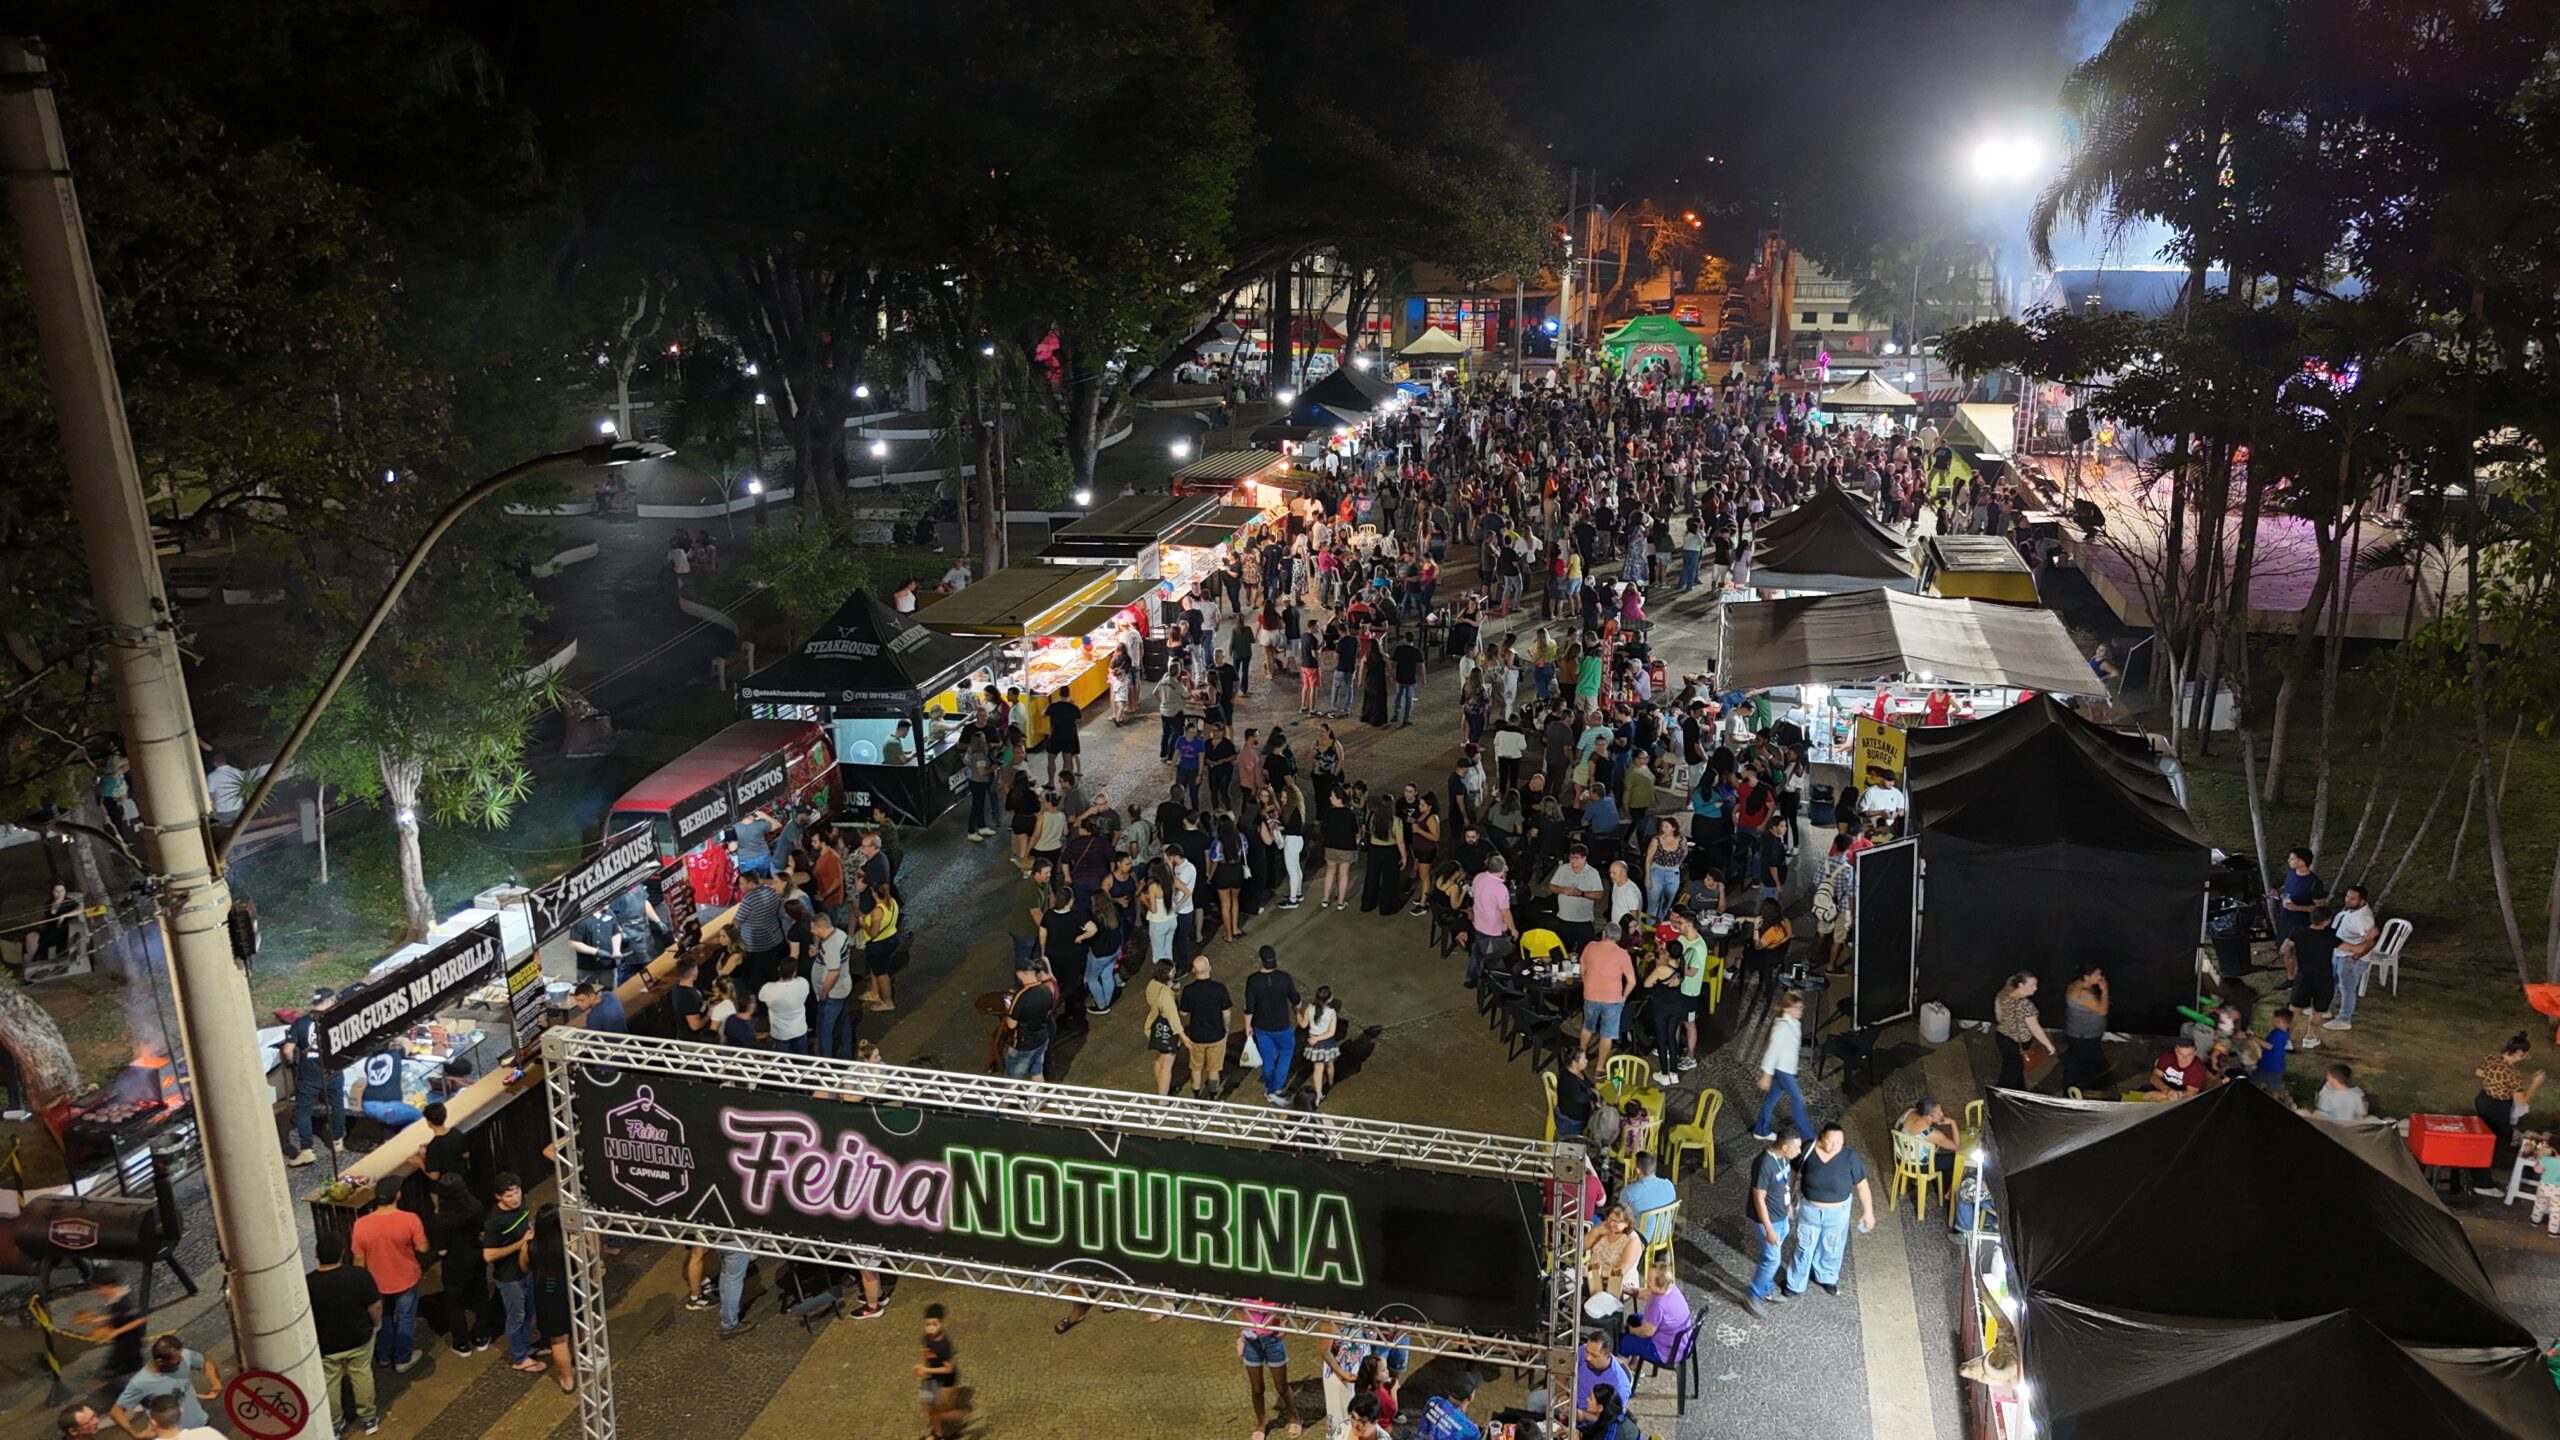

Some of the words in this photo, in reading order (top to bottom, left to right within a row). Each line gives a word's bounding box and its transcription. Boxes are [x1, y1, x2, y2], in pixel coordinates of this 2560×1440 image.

[804, 639, 880, 656] STEAKHOUSE
[1862, 737, 1898, 759] ARTESANAL
[1867, 748, 1893, 766] BURGER
[737, 766, 784, 805] ESPETOS
[679, 796, 728, 838] BEBIDAS
[568, 829, 654, 902] STEAKHOUSE
[328, 987, 409, 1055] BURGUERS
[408, 974, 432, 1008] NA
[431, 937, 494, 995] PARRILLA
[625, 1119, 668, 1142] Feira
[604, 1137, 695, 1169] NOTURNA
[629, 1166, 670, 1180] CAPIVARI
[722, 1109, 951, 1228] Feira
[945, 1146, 1364, 1287] NOTURNA
